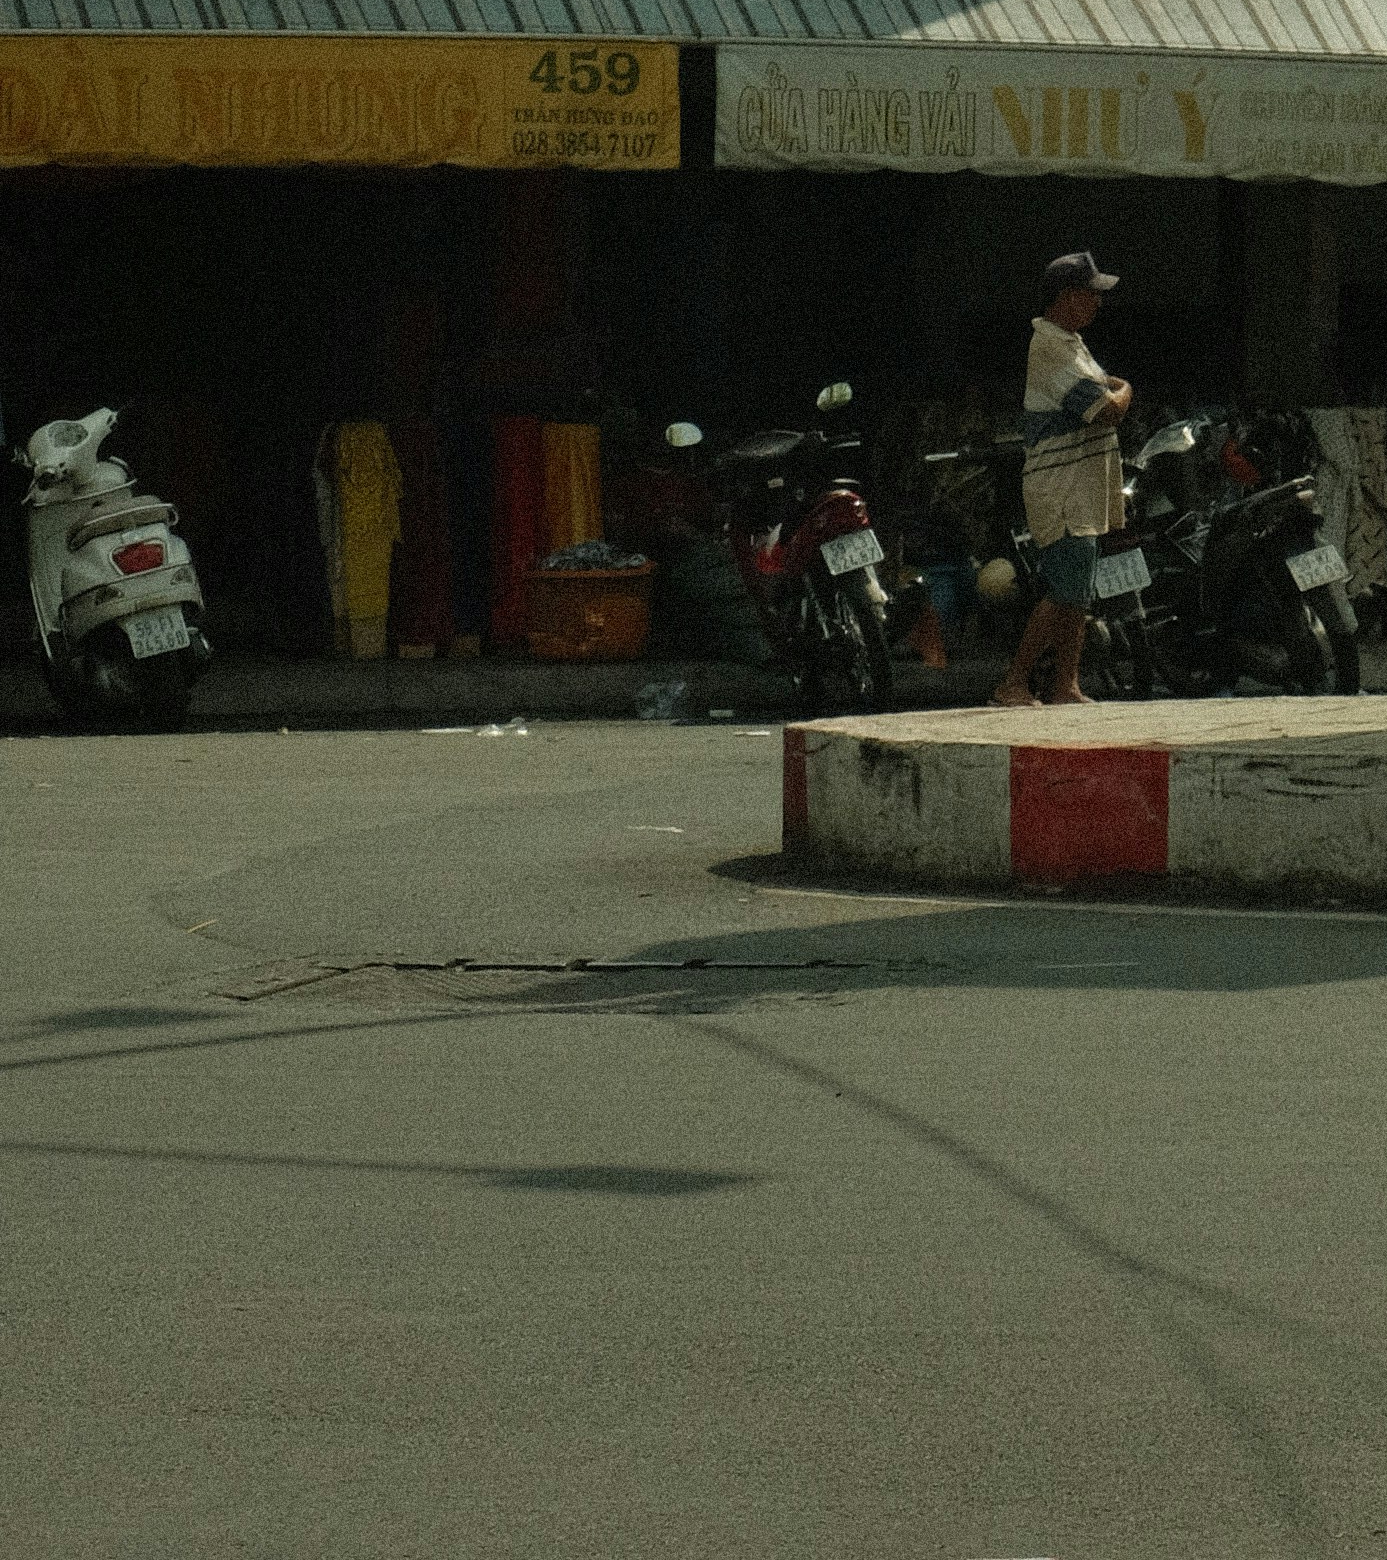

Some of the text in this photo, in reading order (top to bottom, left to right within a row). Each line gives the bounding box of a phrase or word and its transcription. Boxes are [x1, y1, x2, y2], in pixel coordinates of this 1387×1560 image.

[528, 48, 641, 96] 459
[817, 70, 911, 156] HÀNG
[990, 70, 1150, 161] NHƯ
[1172, 68, 1225, 163] Ý
